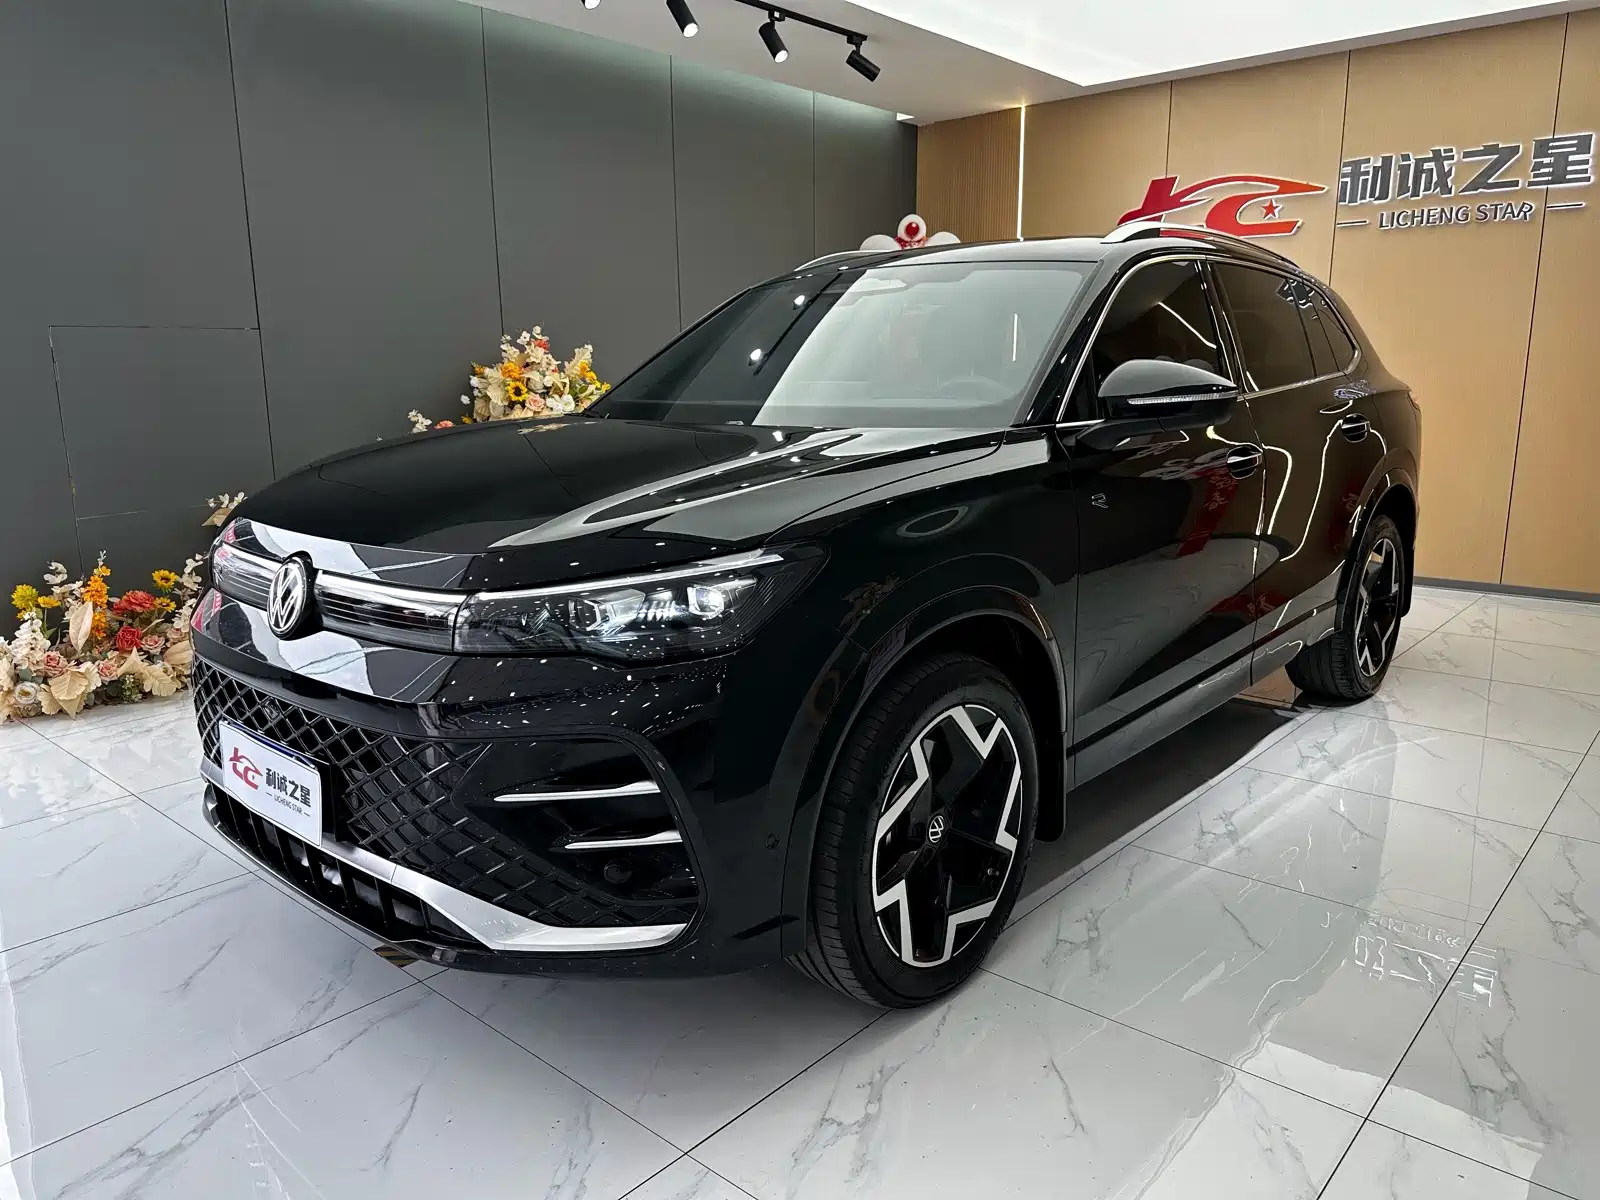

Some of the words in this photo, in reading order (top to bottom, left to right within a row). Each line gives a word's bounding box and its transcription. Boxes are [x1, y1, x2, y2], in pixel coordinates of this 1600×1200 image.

[1338, 133, 1594, 205] 利诚之星
[1379, 204, 1470, 230] LICHENG
[1475, 201, 1535, 222] STAR
[265, 767, 311, 808] 利诚之星
[273, 794, 292, 809] LICHENG
[291, 803, 303, 815] STAR
